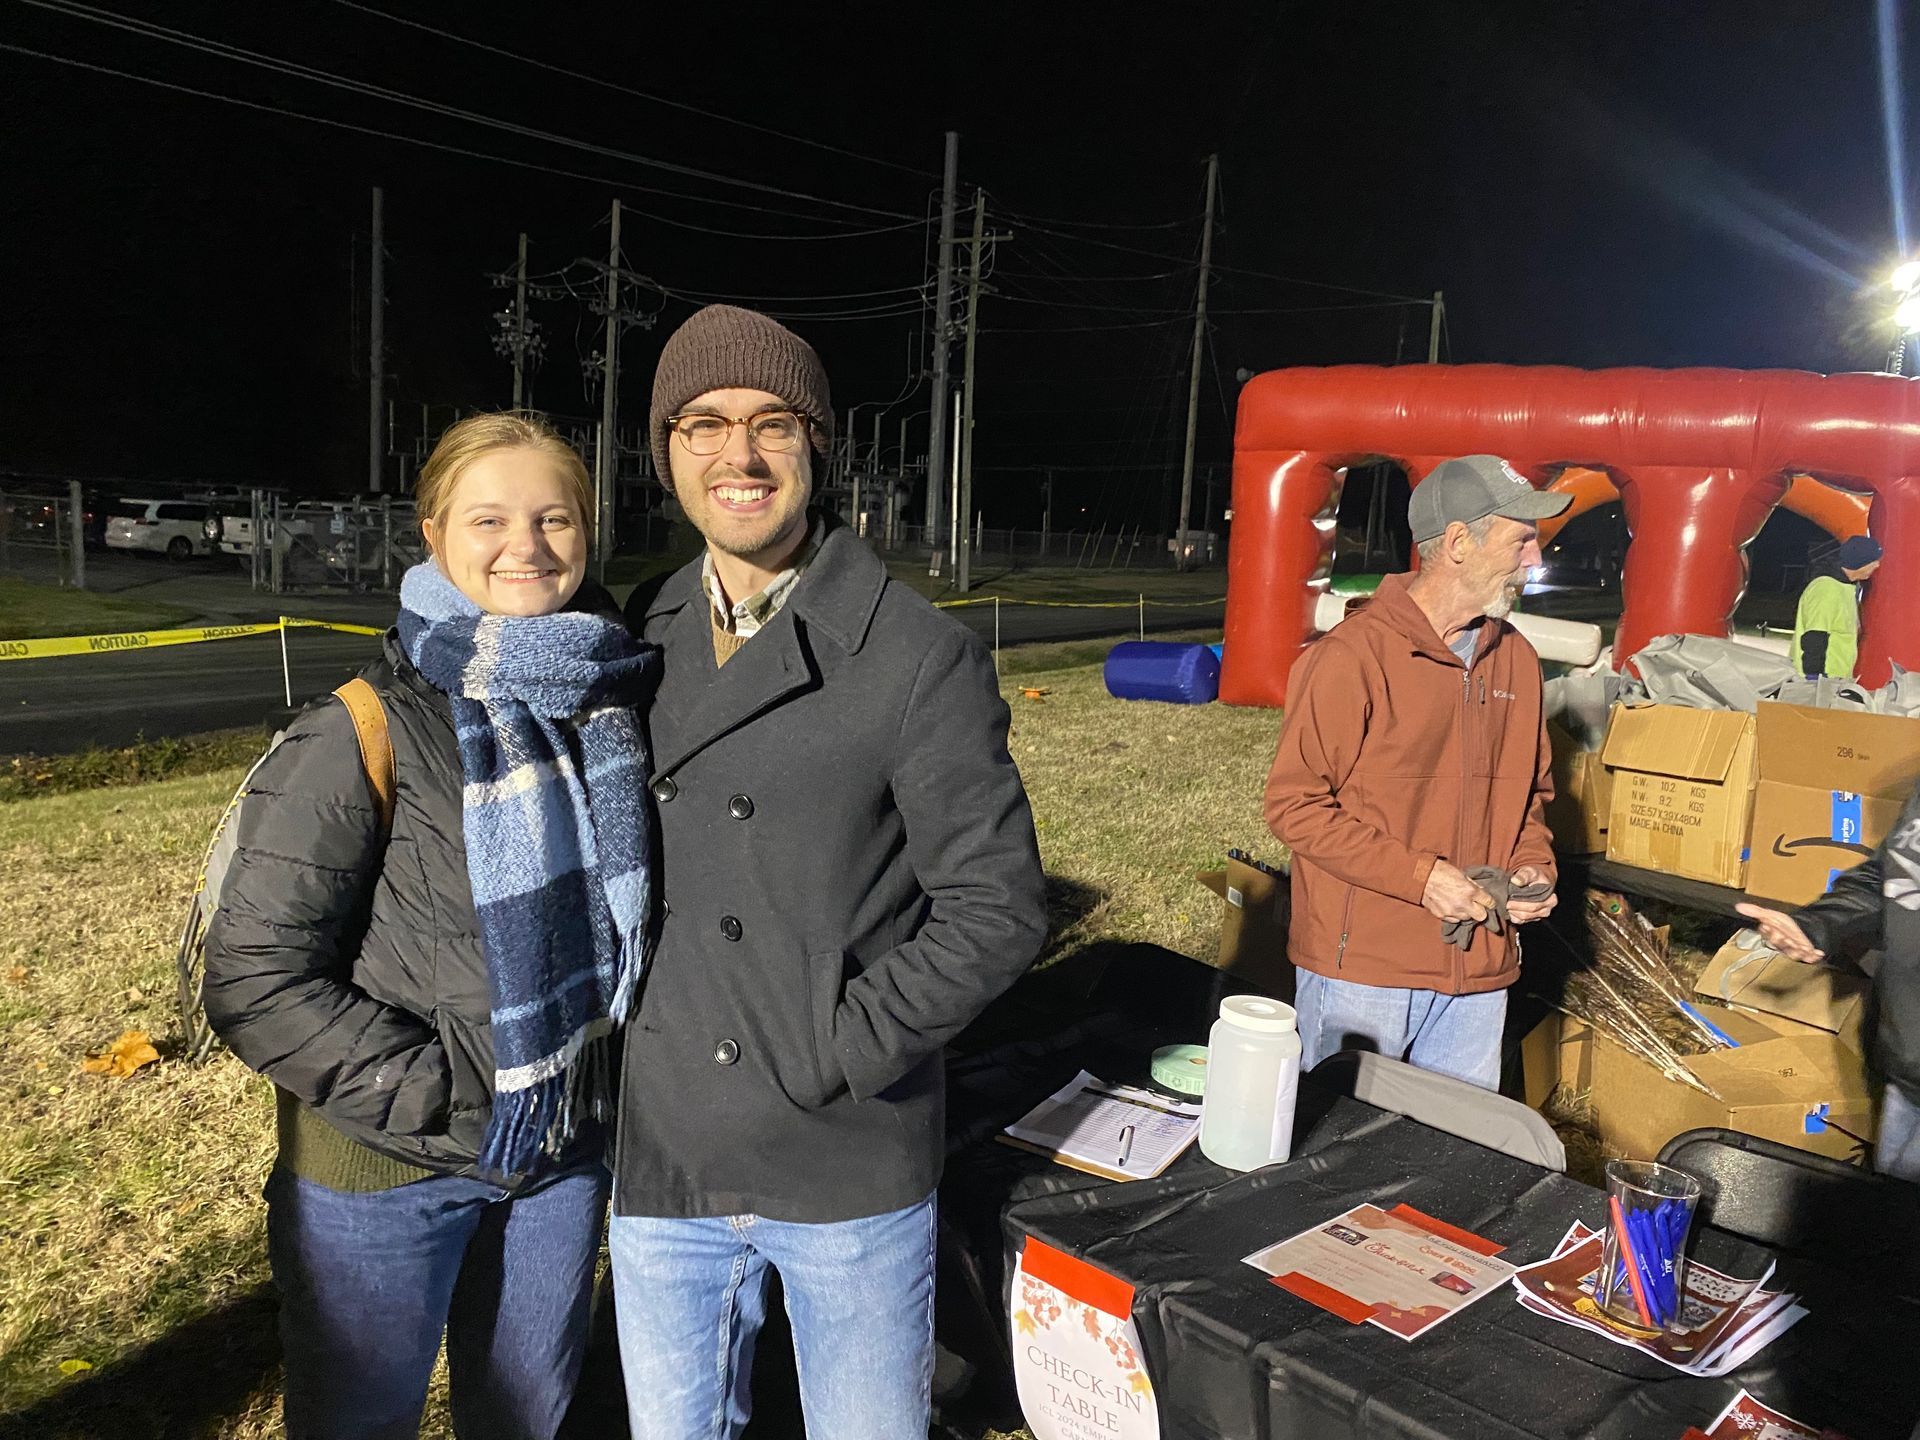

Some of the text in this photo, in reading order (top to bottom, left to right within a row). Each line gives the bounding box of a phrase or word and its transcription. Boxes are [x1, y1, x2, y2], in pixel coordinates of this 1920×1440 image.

[1690, 786, 1707, 799] KGS
[1688, 800, 1705, 813] KGS
[1629, 816, 1652, 830] MADE
[1662, 823, 1684, 838] CHINA
[1026, 1345, 1142, 1414] CHECK-IN
[1046, 1383, 1120, 1433] TABLE
